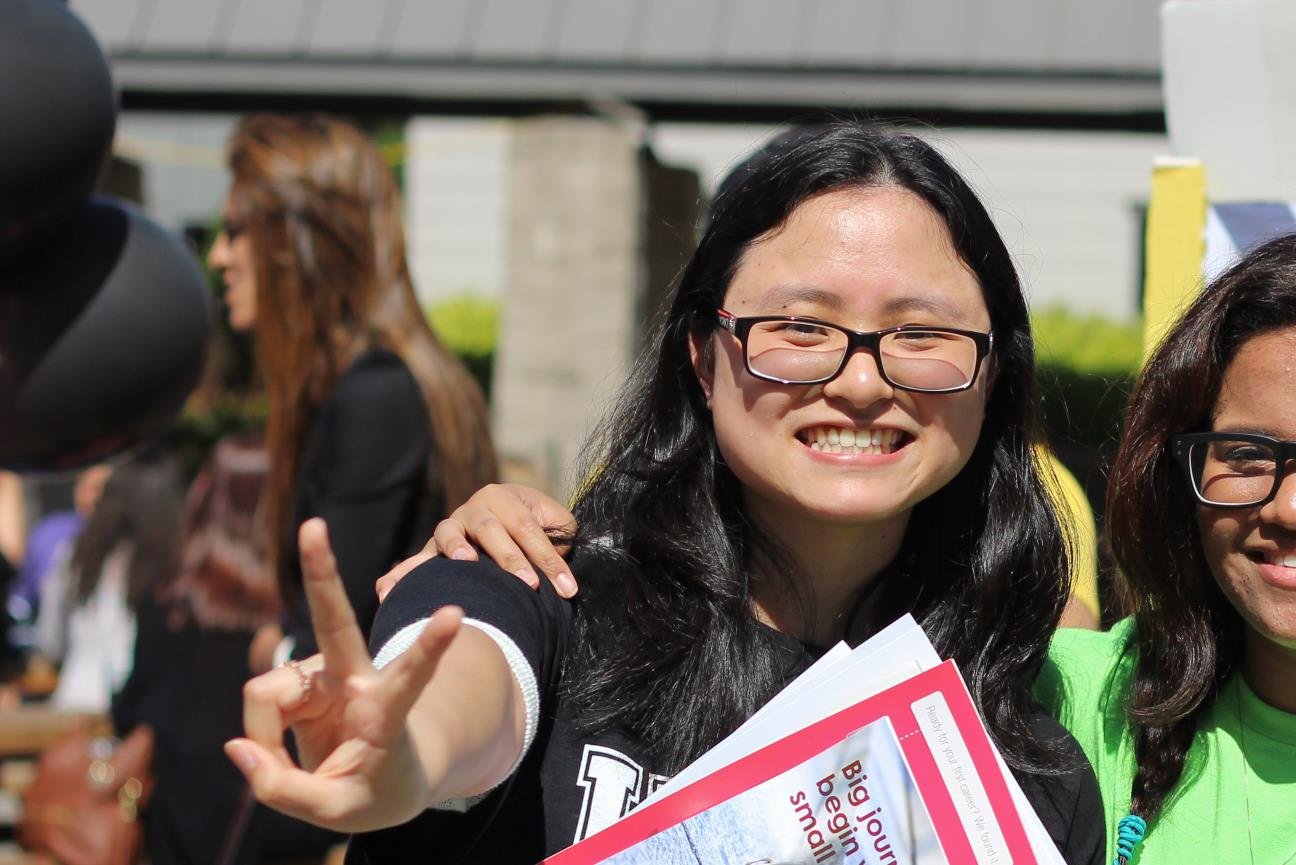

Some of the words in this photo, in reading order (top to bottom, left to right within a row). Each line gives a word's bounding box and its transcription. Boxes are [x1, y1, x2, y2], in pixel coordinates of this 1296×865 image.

[816, 773, 859, 857] begin
[841, 760, 870, 807] Big
[925, 705, 943, 733] Ready
[942, 746, 958, 766] your
[953, 766, 967, 783] first
[960, 782, 980, 814] career?
[974, 815, 985, 832] We
[980, 831, 997, 857] found
[790, 791, 836, 864] small
